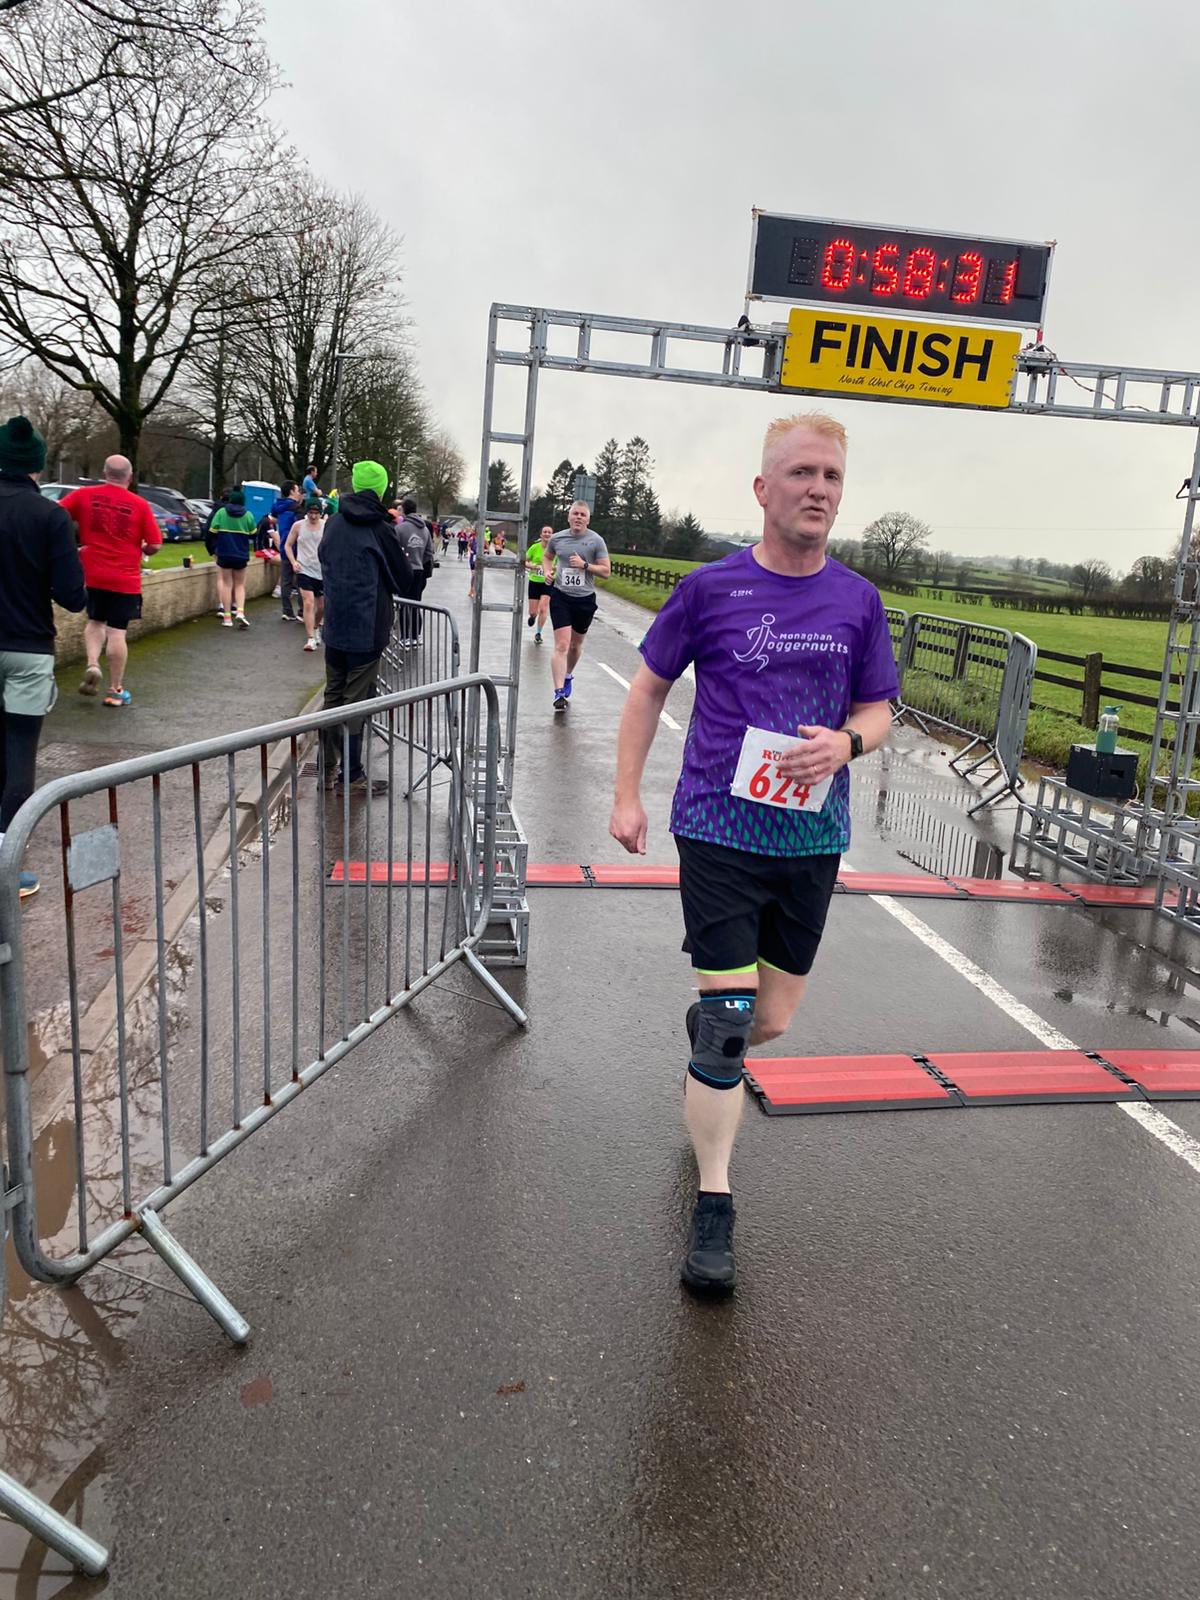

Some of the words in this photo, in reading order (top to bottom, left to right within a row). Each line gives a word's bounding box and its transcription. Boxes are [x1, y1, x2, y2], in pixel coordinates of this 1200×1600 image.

[821, 237, 1019, 304] 0:58:31
[809, 319, 994, 382] FINISH
[838, 374, 865, 385] North
[868, 376, 893, 388] West
[894, 379, 915, 392] Chip
[918, 381, 953, 396] Timing
[565, 575, 581, 586] 346
[748, 763, 812, 807] 624
